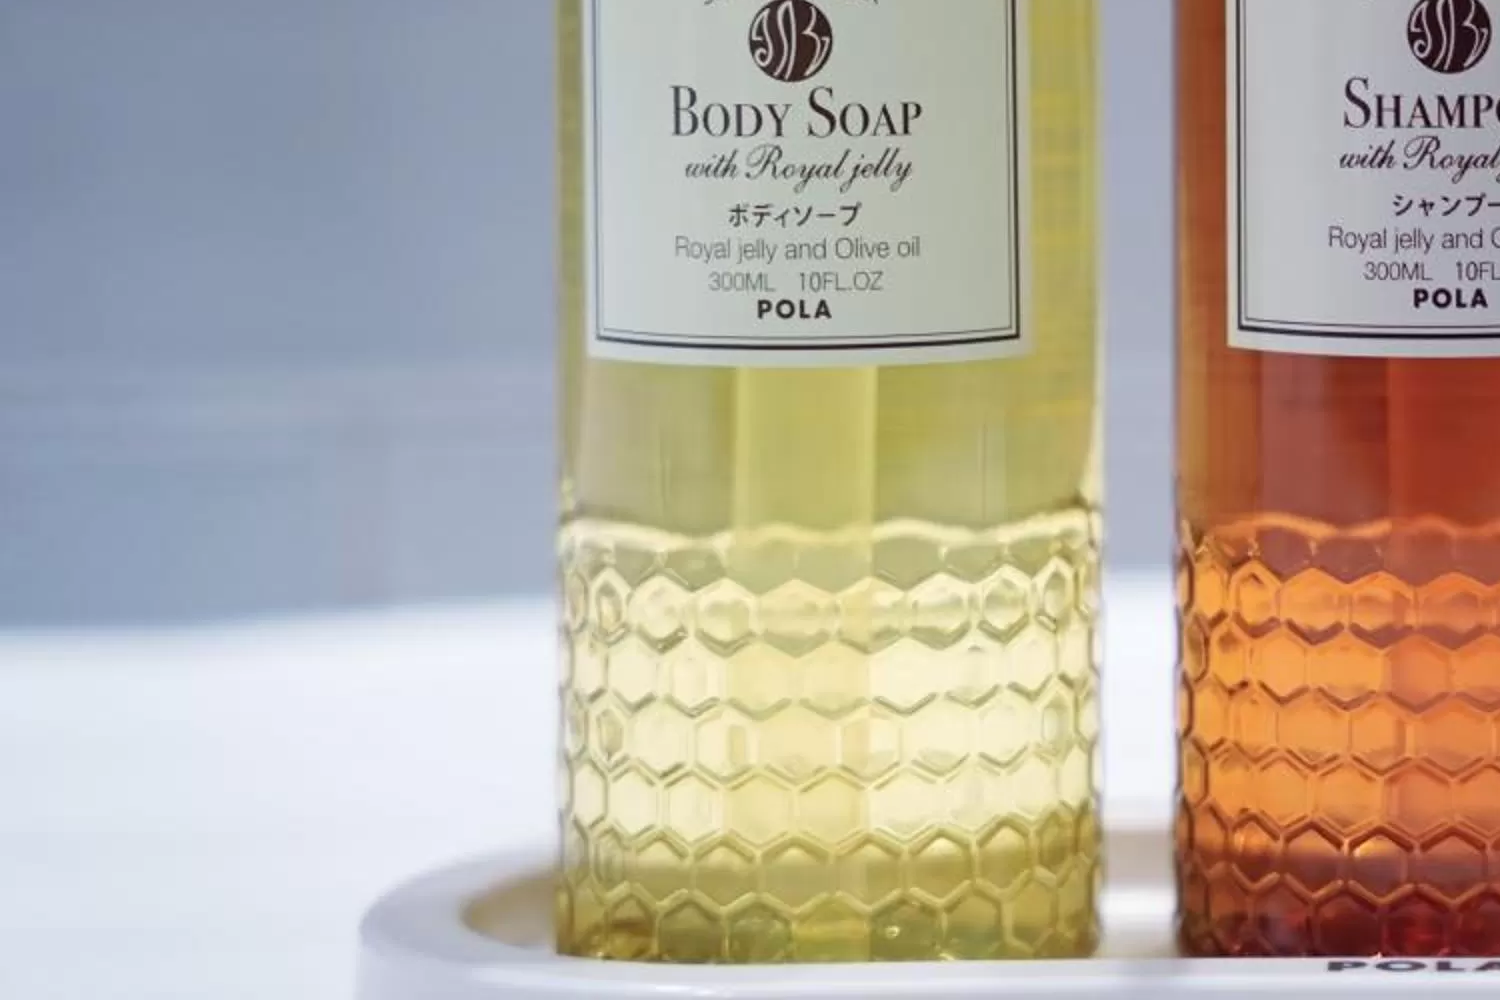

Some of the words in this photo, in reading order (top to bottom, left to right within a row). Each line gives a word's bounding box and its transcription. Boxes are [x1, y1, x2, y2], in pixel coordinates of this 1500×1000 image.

[684, 148, 740, 179] with
[746, 145, 844, 193] Royal
[839, 148, 912, 193] jelly
[1339, 139, 1397, 169] with
[1402, 135, 1500, 184] Royal
[675, 236, 732, 263] Royal
[737, 238, 777, 263] jelly
[784, 238, 827, 260] and
[834, 237, 890, 259] Olive
[897, 235, 920, 258] oil
[1329, 226, 1388, 252] Royal
[1394, 227, 1435, 252] jelly
[1441, 228, 1483, 249] and
[708, 272, 776, 292] 300ML
[799, 271, 883, 292] 10FL.OZ
[1363, 261, 1432, 281] 300ML
[758, 299, 832, 320] POLA
[1414, 288, 1488, 309] POLA
